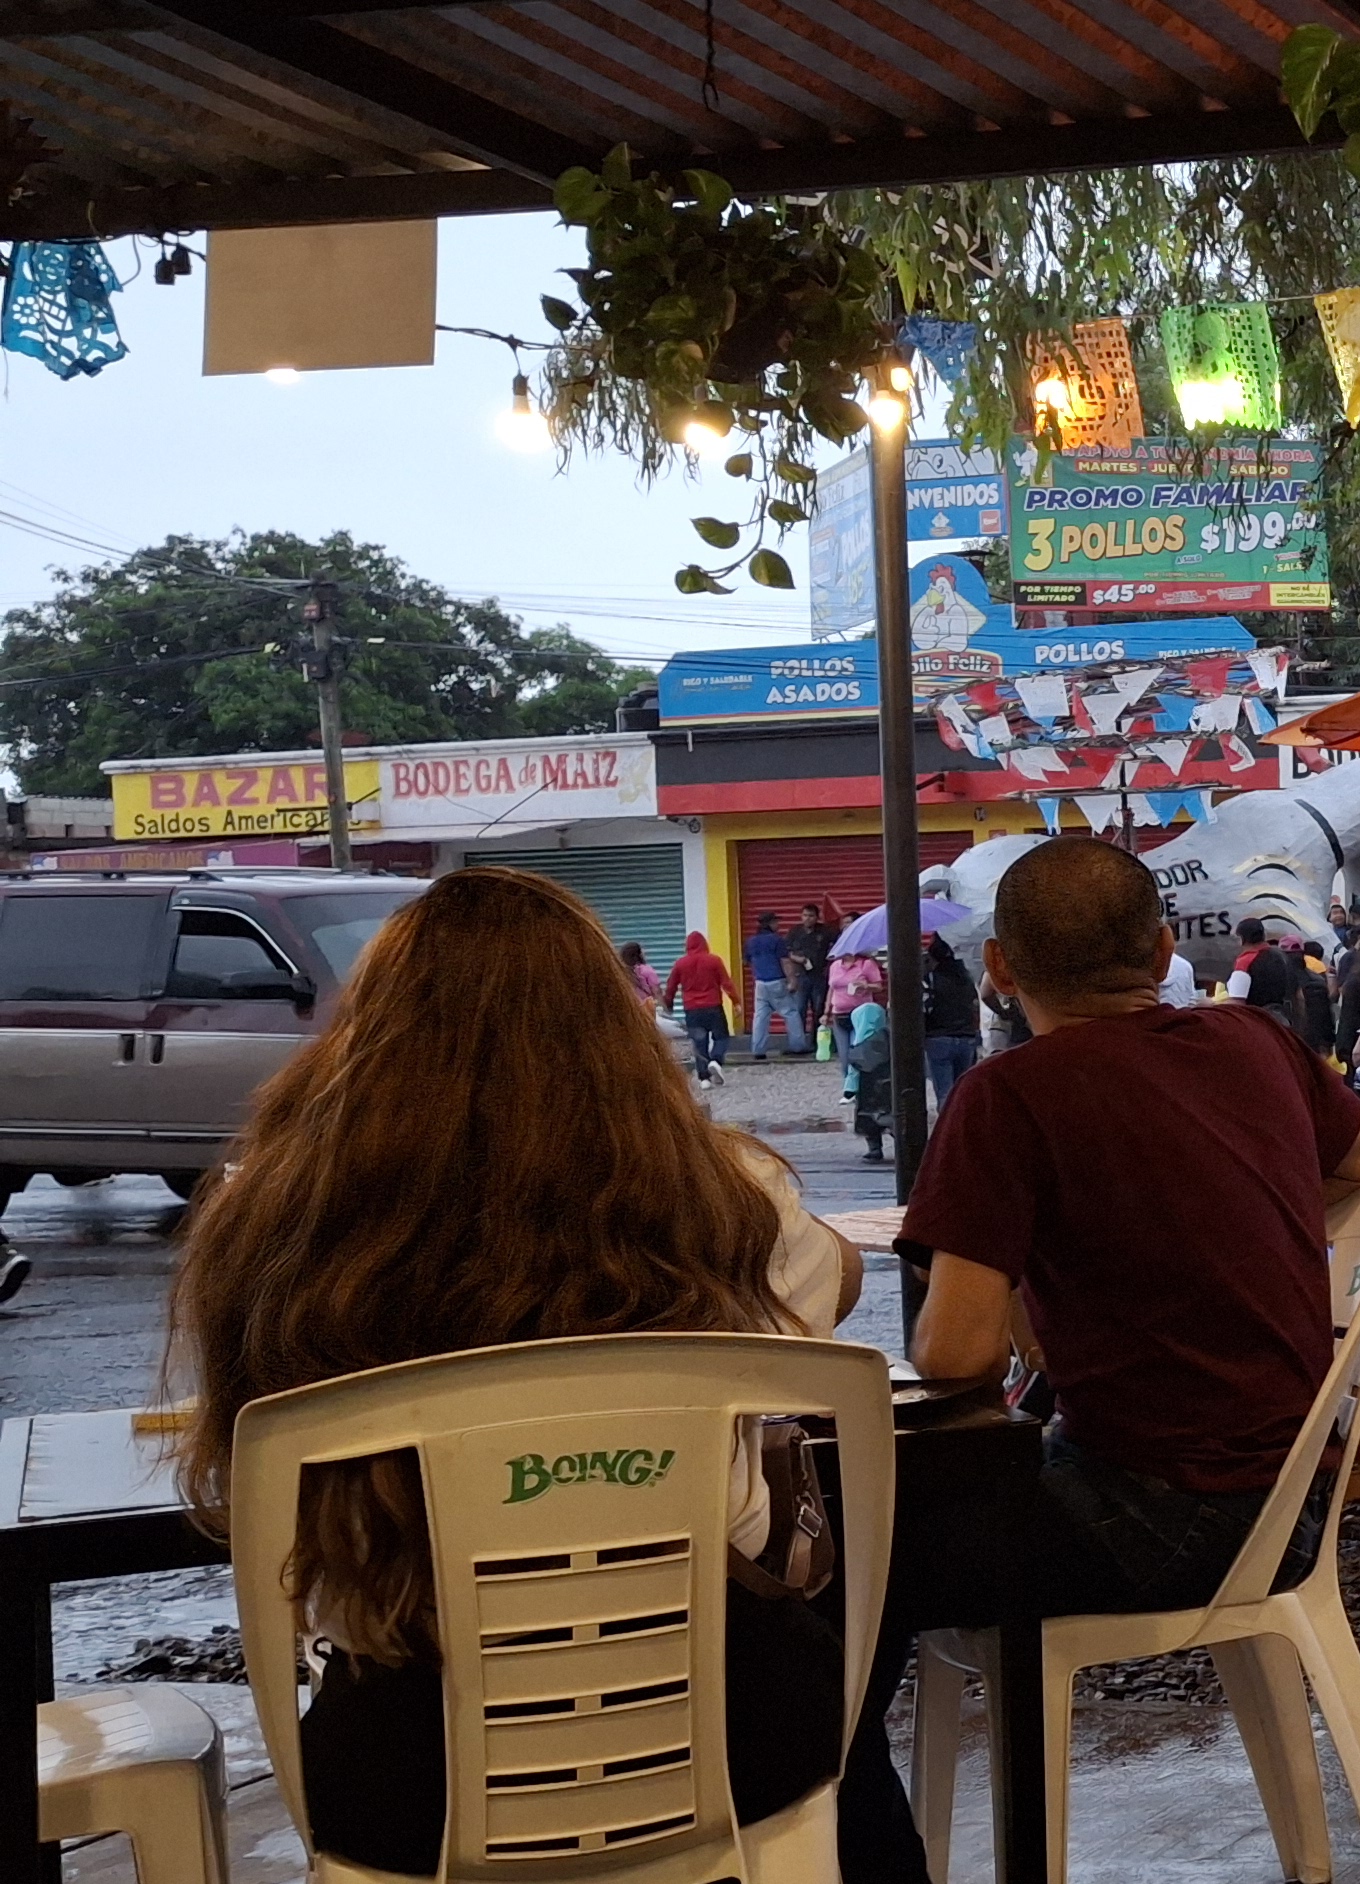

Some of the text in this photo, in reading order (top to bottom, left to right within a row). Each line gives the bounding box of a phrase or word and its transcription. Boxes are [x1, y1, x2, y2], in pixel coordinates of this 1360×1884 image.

[1078, 461, 1138, 473] MARTES
[1024, 485, 1145, 511] PROMO
[1023, 517, 1056, 571] 3
[1059, 513, 1186, 563] POLLOS
[1020, 585, 1082, 593] POR TIEMPO
[1027, 594, 1076, 602] LIMITADO
[1093, 583, 1156, 605] $45.00
[912, 654, 992, 675] ollo Feliz
[1034, 640, 1125, 665] POLLOS
[770, 656, 855, 679] POLLOS
[765, 681, 862, 705] ASADOS
[150, 766, 330, 810] BAZAR
[391, 758, 516, 800] BODEGA
[519, 755, 537, 785] de
[134, 812, 210, 836] Saldos
[1152, 859, 1209, 889] DOR
[502, 1448, 676, 1504] BOING!
